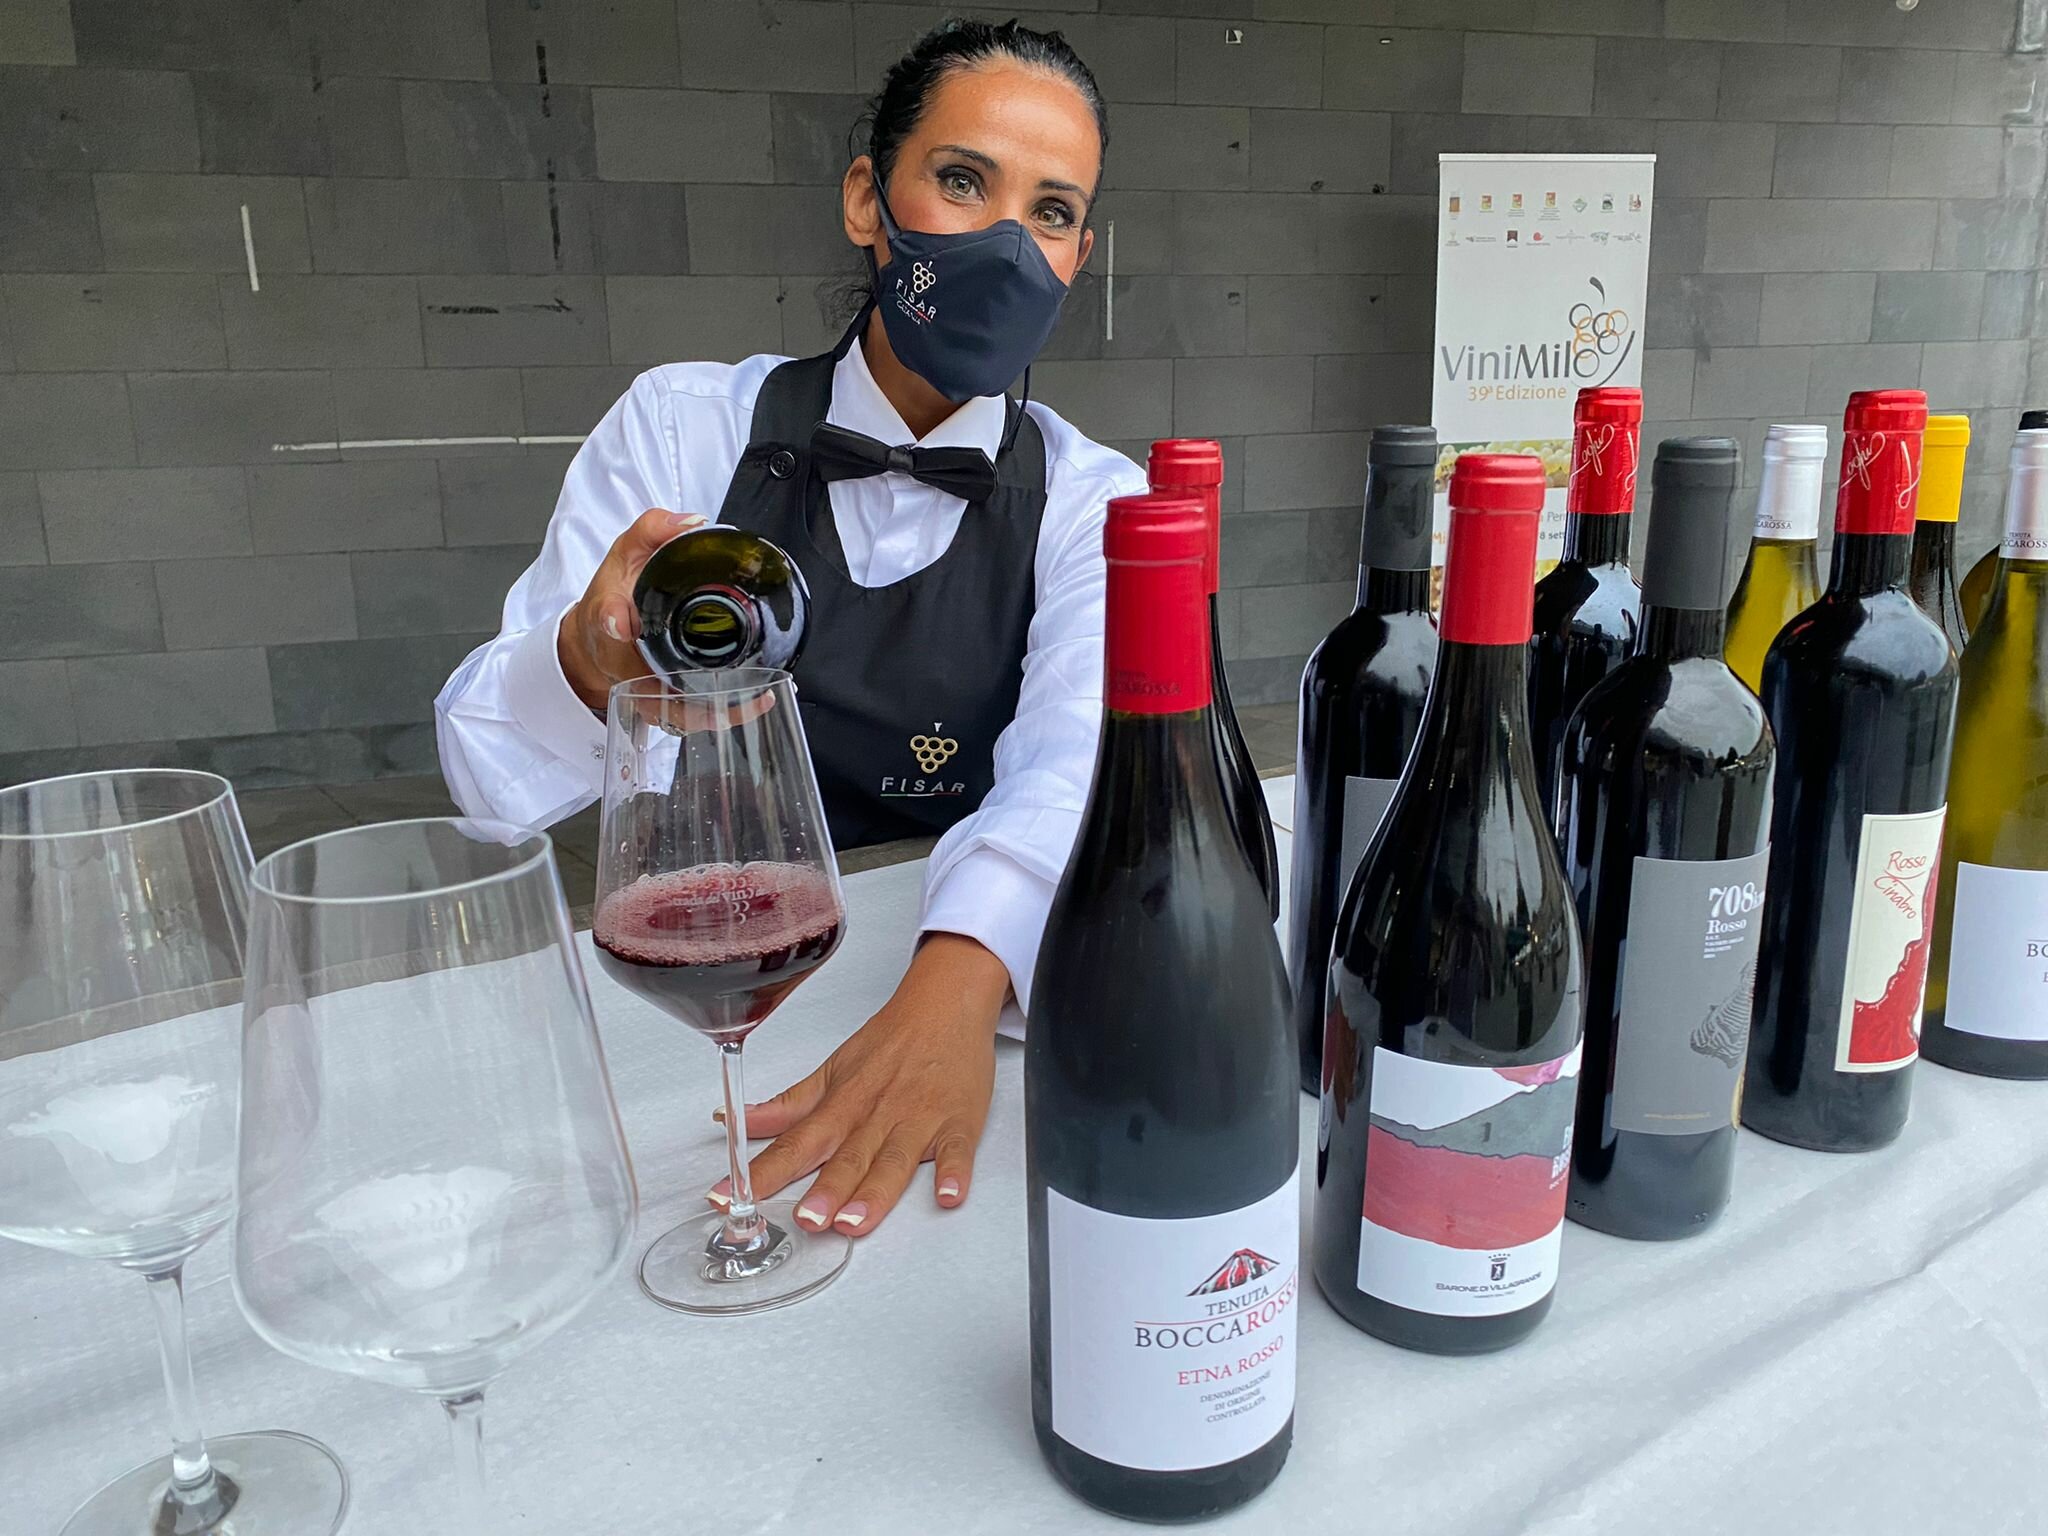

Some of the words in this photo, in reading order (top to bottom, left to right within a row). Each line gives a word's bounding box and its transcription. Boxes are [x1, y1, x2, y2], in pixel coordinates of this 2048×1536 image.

[896, 279, 936, 319] FISAR
[1497, 385, 1567, 401] Edizione
[882, 776, 966, 793] FISAR
[1887, 850, 1927, 872] Rosso
[1873, 874, 1917, 920] Cinabro
[1705, 919, 1748, 935] Rosso
[1205, 1285, 1270, 1317] TENUTA
[1177, 1364, 1232, 1386] ETNA
[1237, 1335, 1284, 1374] ROSSO
[1214, 1402, 1226, 1412] DI
